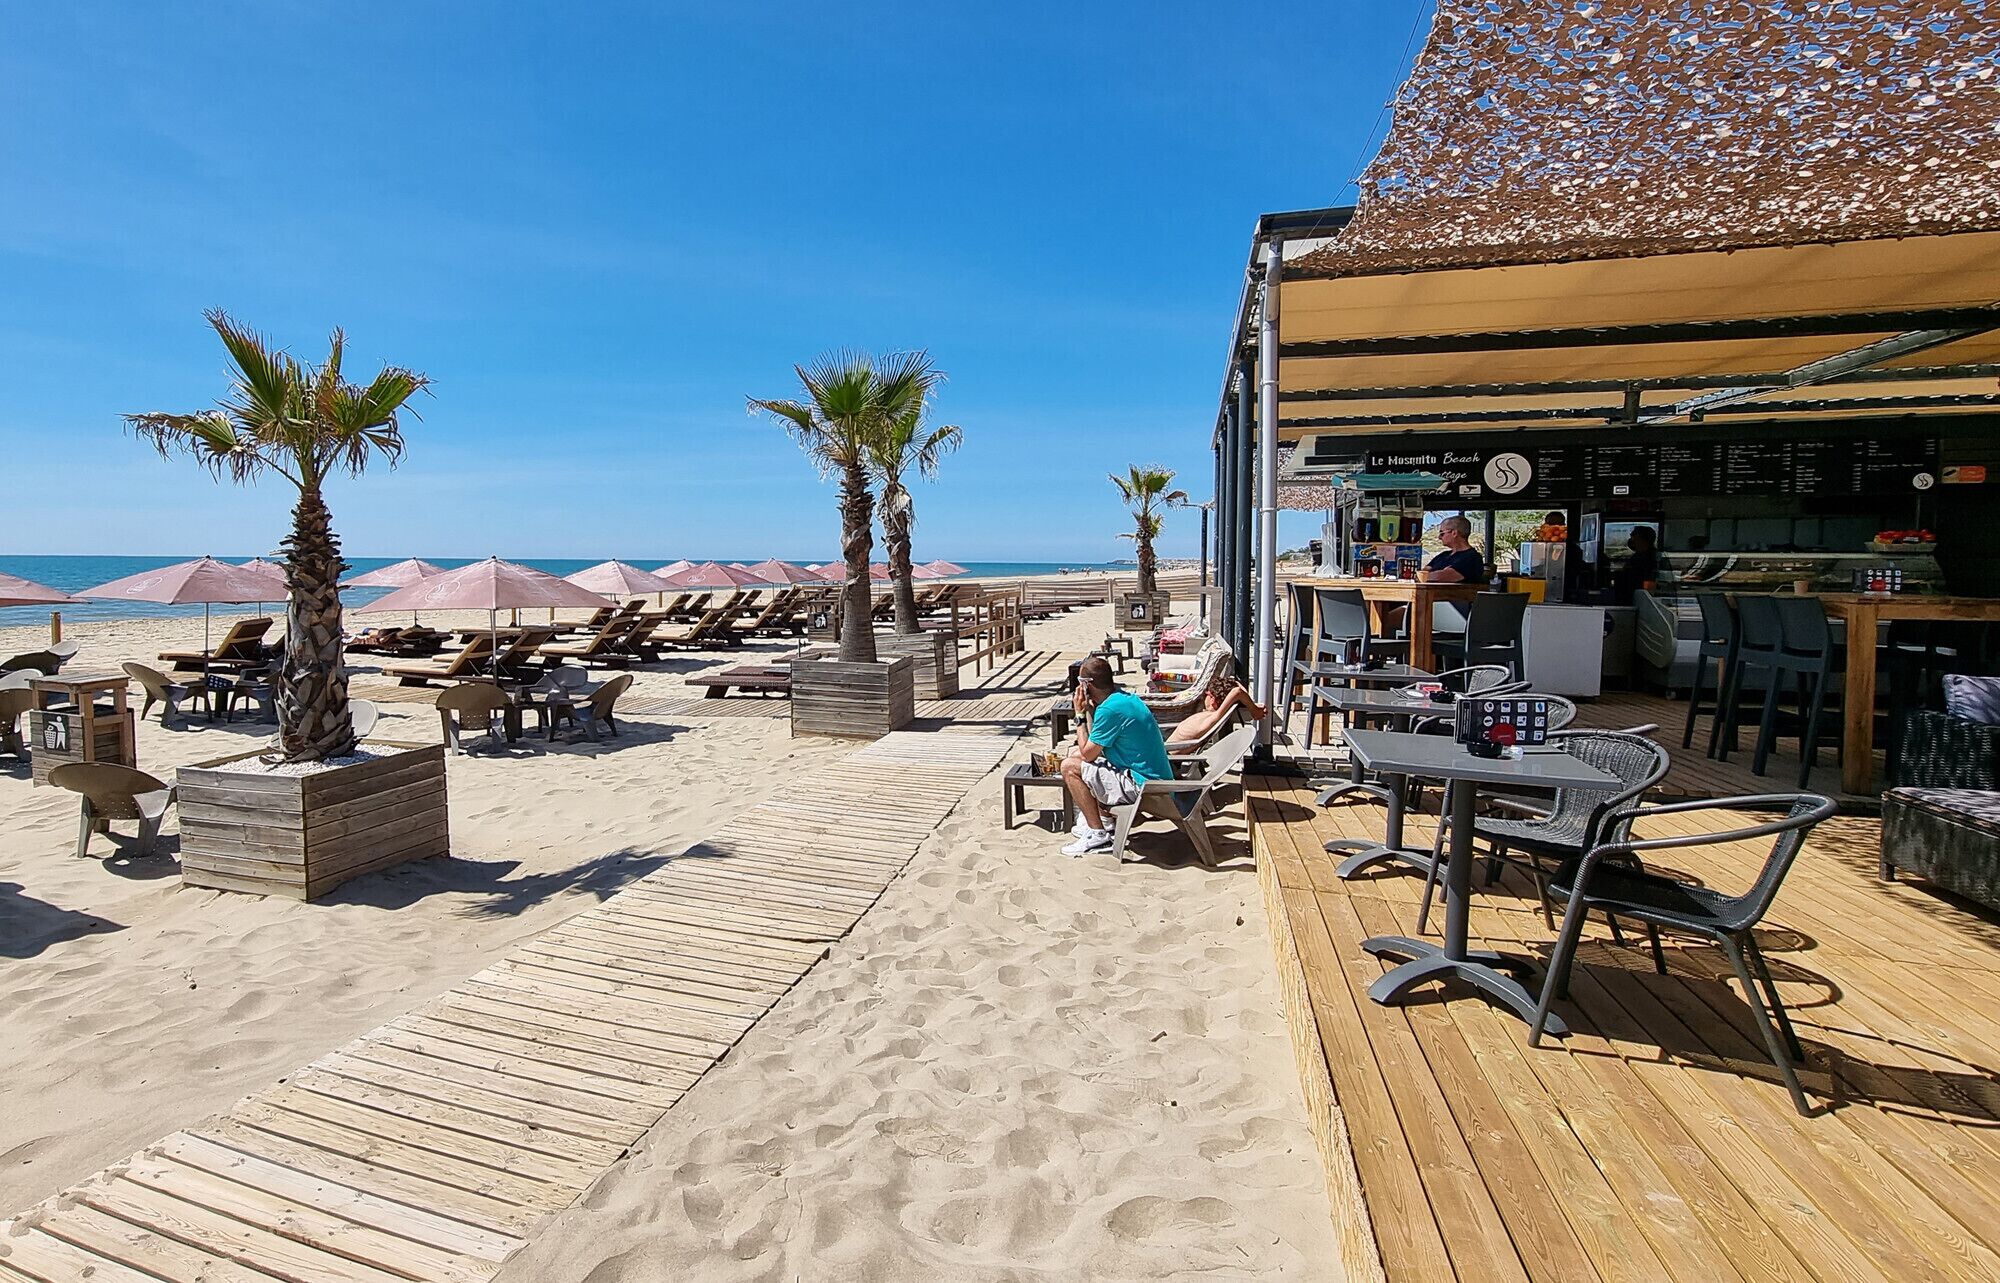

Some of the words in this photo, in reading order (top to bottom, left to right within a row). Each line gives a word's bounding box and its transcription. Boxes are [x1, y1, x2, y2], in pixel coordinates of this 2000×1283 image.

[1372, 456, 1384, 466] Le
[1388, 455, 1437, 466] Mosquito
[1443, 452, 1480, 465] Beach
